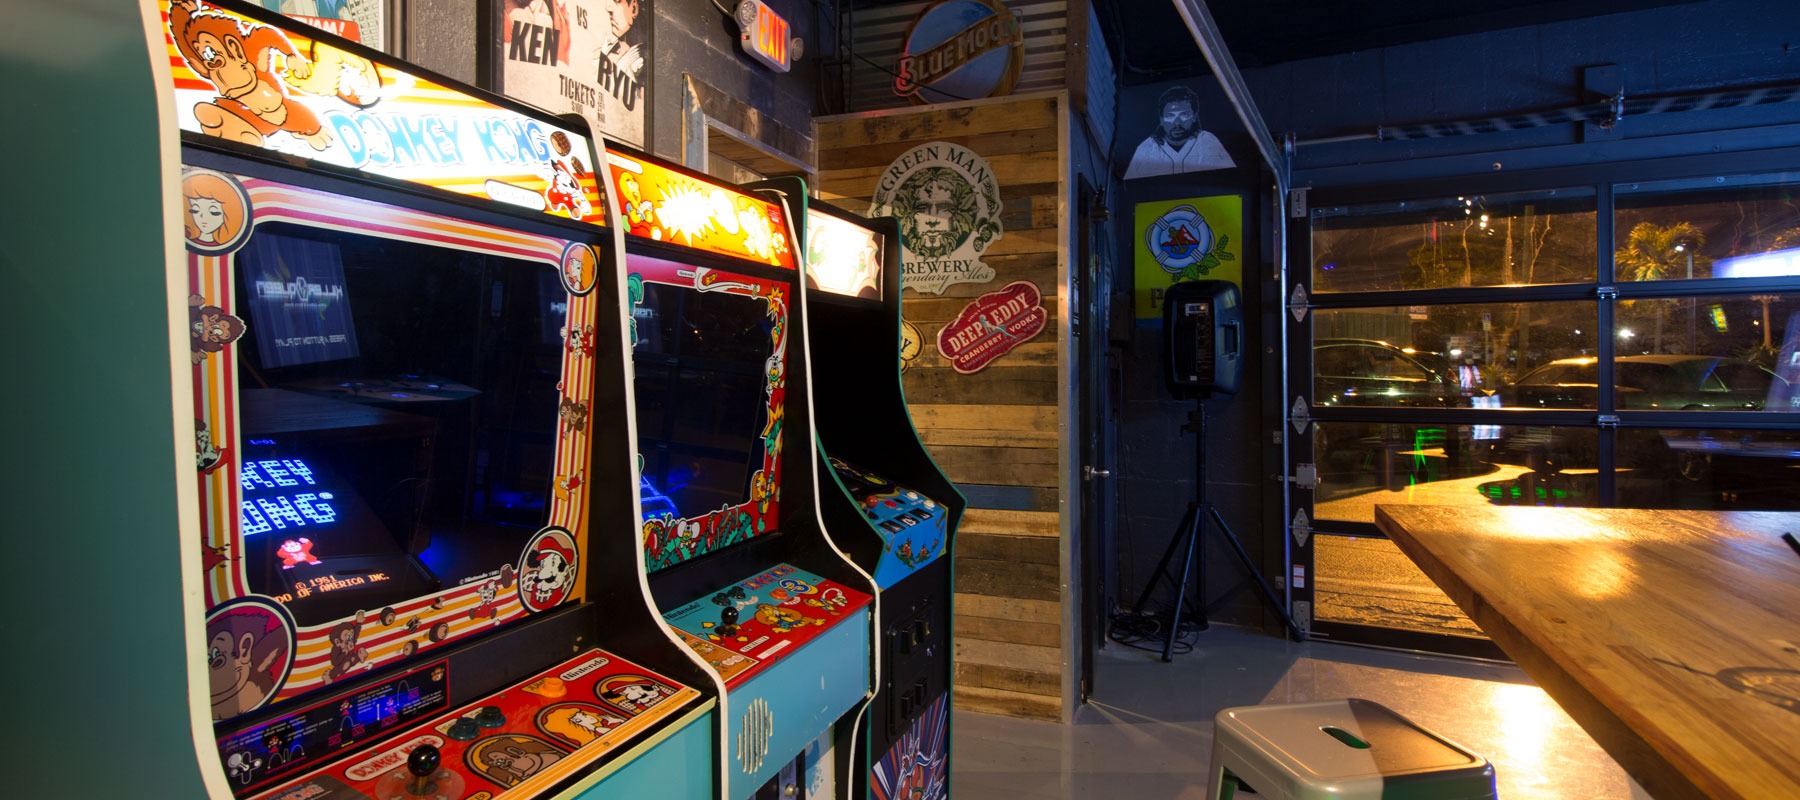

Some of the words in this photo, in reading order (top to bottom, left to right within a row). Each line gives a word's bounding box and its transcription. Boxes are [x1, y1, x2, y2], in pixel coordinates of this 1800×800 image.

[576, 5, 588, 30] VS
[758, 6, 787, 65] EXIT
[508, 20, 561, 67] KEN
[559, 74, 595, 108] TICKETS
[597, 52, 637, 112] RYU
[896, 45, 954, 91] BLUE
[331, 110, 466, 168] DONKEY
[476, 117, 550, 166] KONG
[881, 146, 939, 192] GREEN
[946, 147, 989, 184] MAN
[948, 321, 983, 353] DEEP
[990, 293, 1030, 326] EDDY
[960, 334, 1002, 363] CRANBERRY
[1009, 314, 1038, 332] VODKA
[273, 593, 292, 604] DO
[297, 588, 312, 599] OF
[319, 578, 365, 592] AMERICA
[368, 573, 390, 583] INC.
[310, 575, 337, 587] 1981
[562, 657, 607, 681] Nintendo
[351, 752, 402, 778] DONKEY
